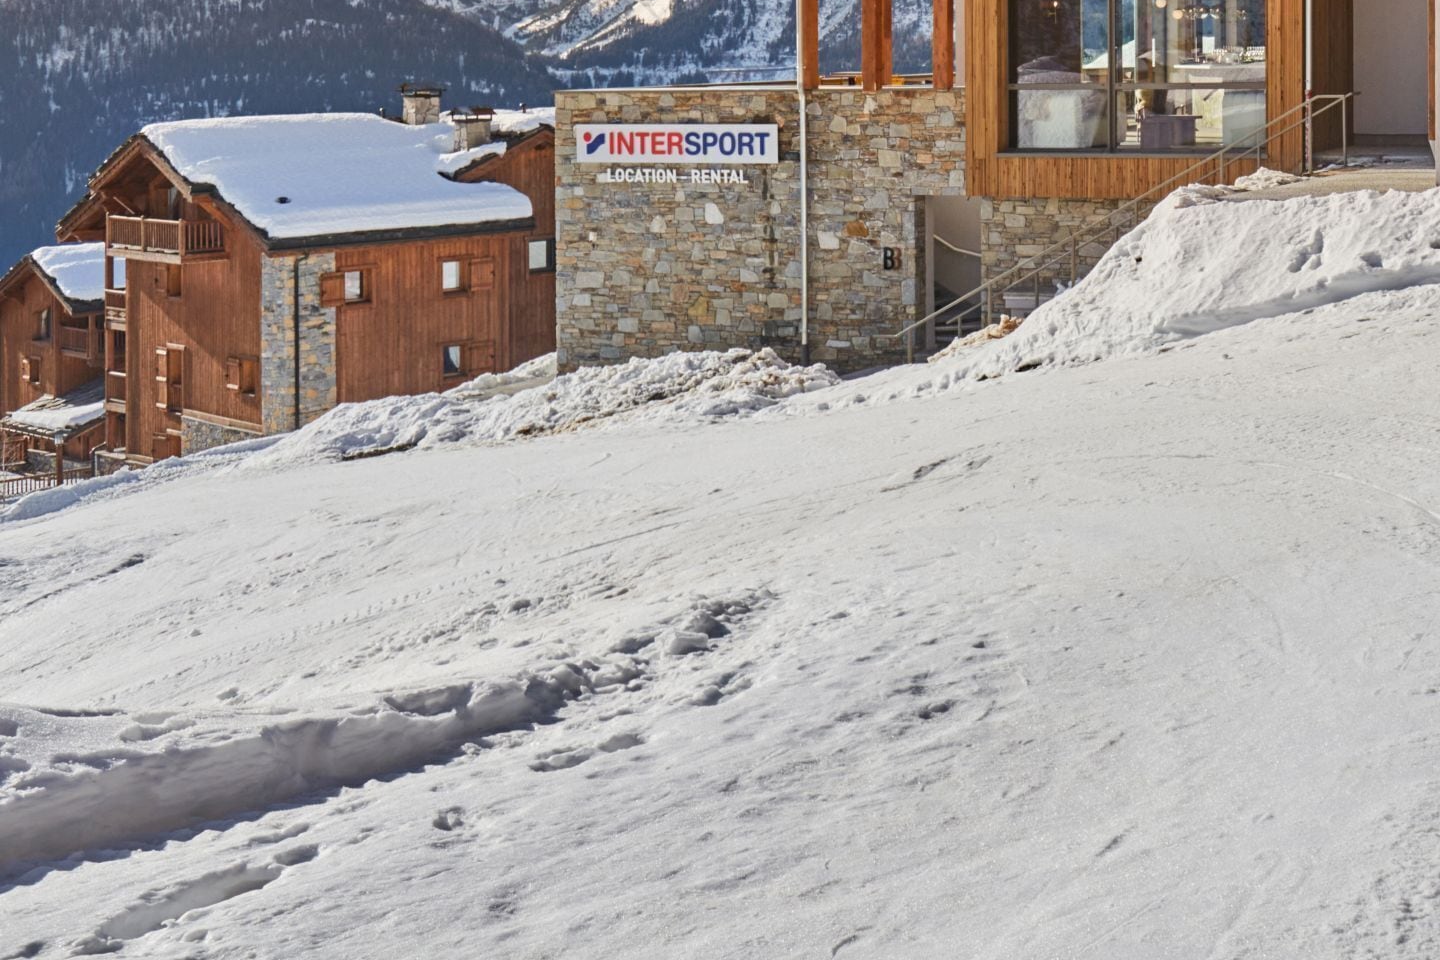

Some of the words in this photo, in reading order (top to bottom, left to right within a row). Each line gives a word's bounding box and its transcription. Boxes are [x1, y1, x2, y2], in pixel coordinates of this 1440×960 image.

[609, 131, 770, 156] INTERSPORT
[607, 168, 677, 183] LOCATION
[691, 169, 749, 184] RENTAL
